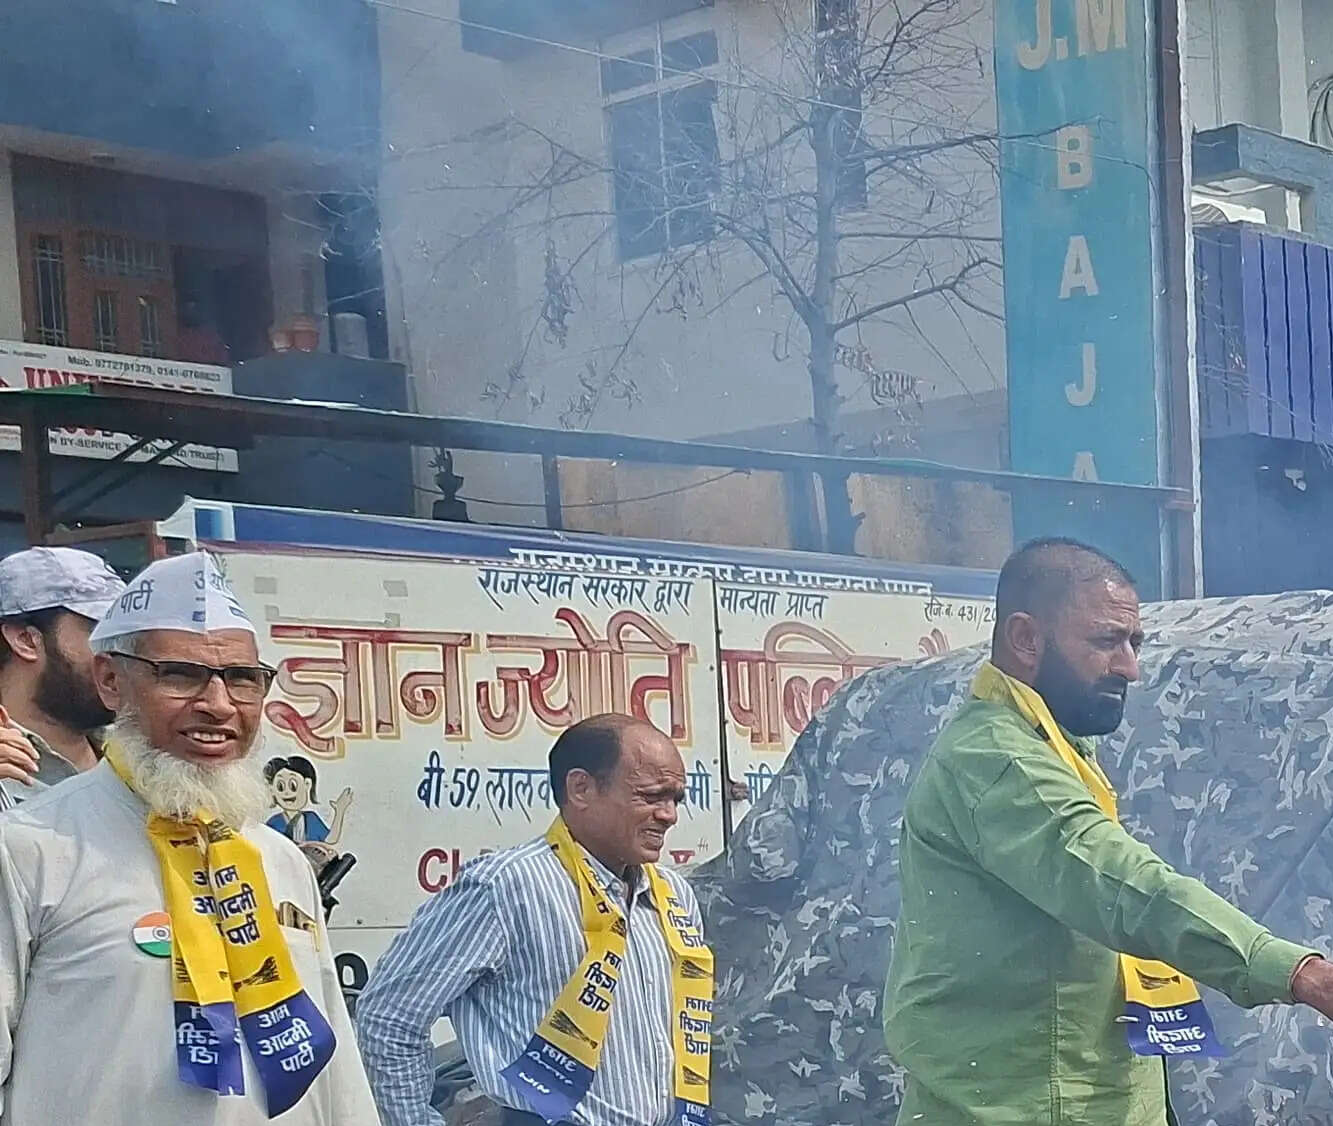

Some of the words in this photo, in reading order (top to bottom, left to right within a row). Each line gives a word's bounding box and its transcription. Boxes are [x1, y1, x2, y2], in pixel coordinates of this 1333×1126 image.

[478, 568, 579, 611] राजस्थान
[581, 573, 651, 613] सरकार
[653, 579, 694, 616] द्वारा
[719, 586, 781, 618] मान्यता
[783, 592, 829, 620] प्राप्त
[264, 624, 472, 753] ज्ञान
[476, 607, 691, 741] ज्योति
[259, 1005, 290, 1027] आम
[259, 1019, 312, 1056] आदमी
